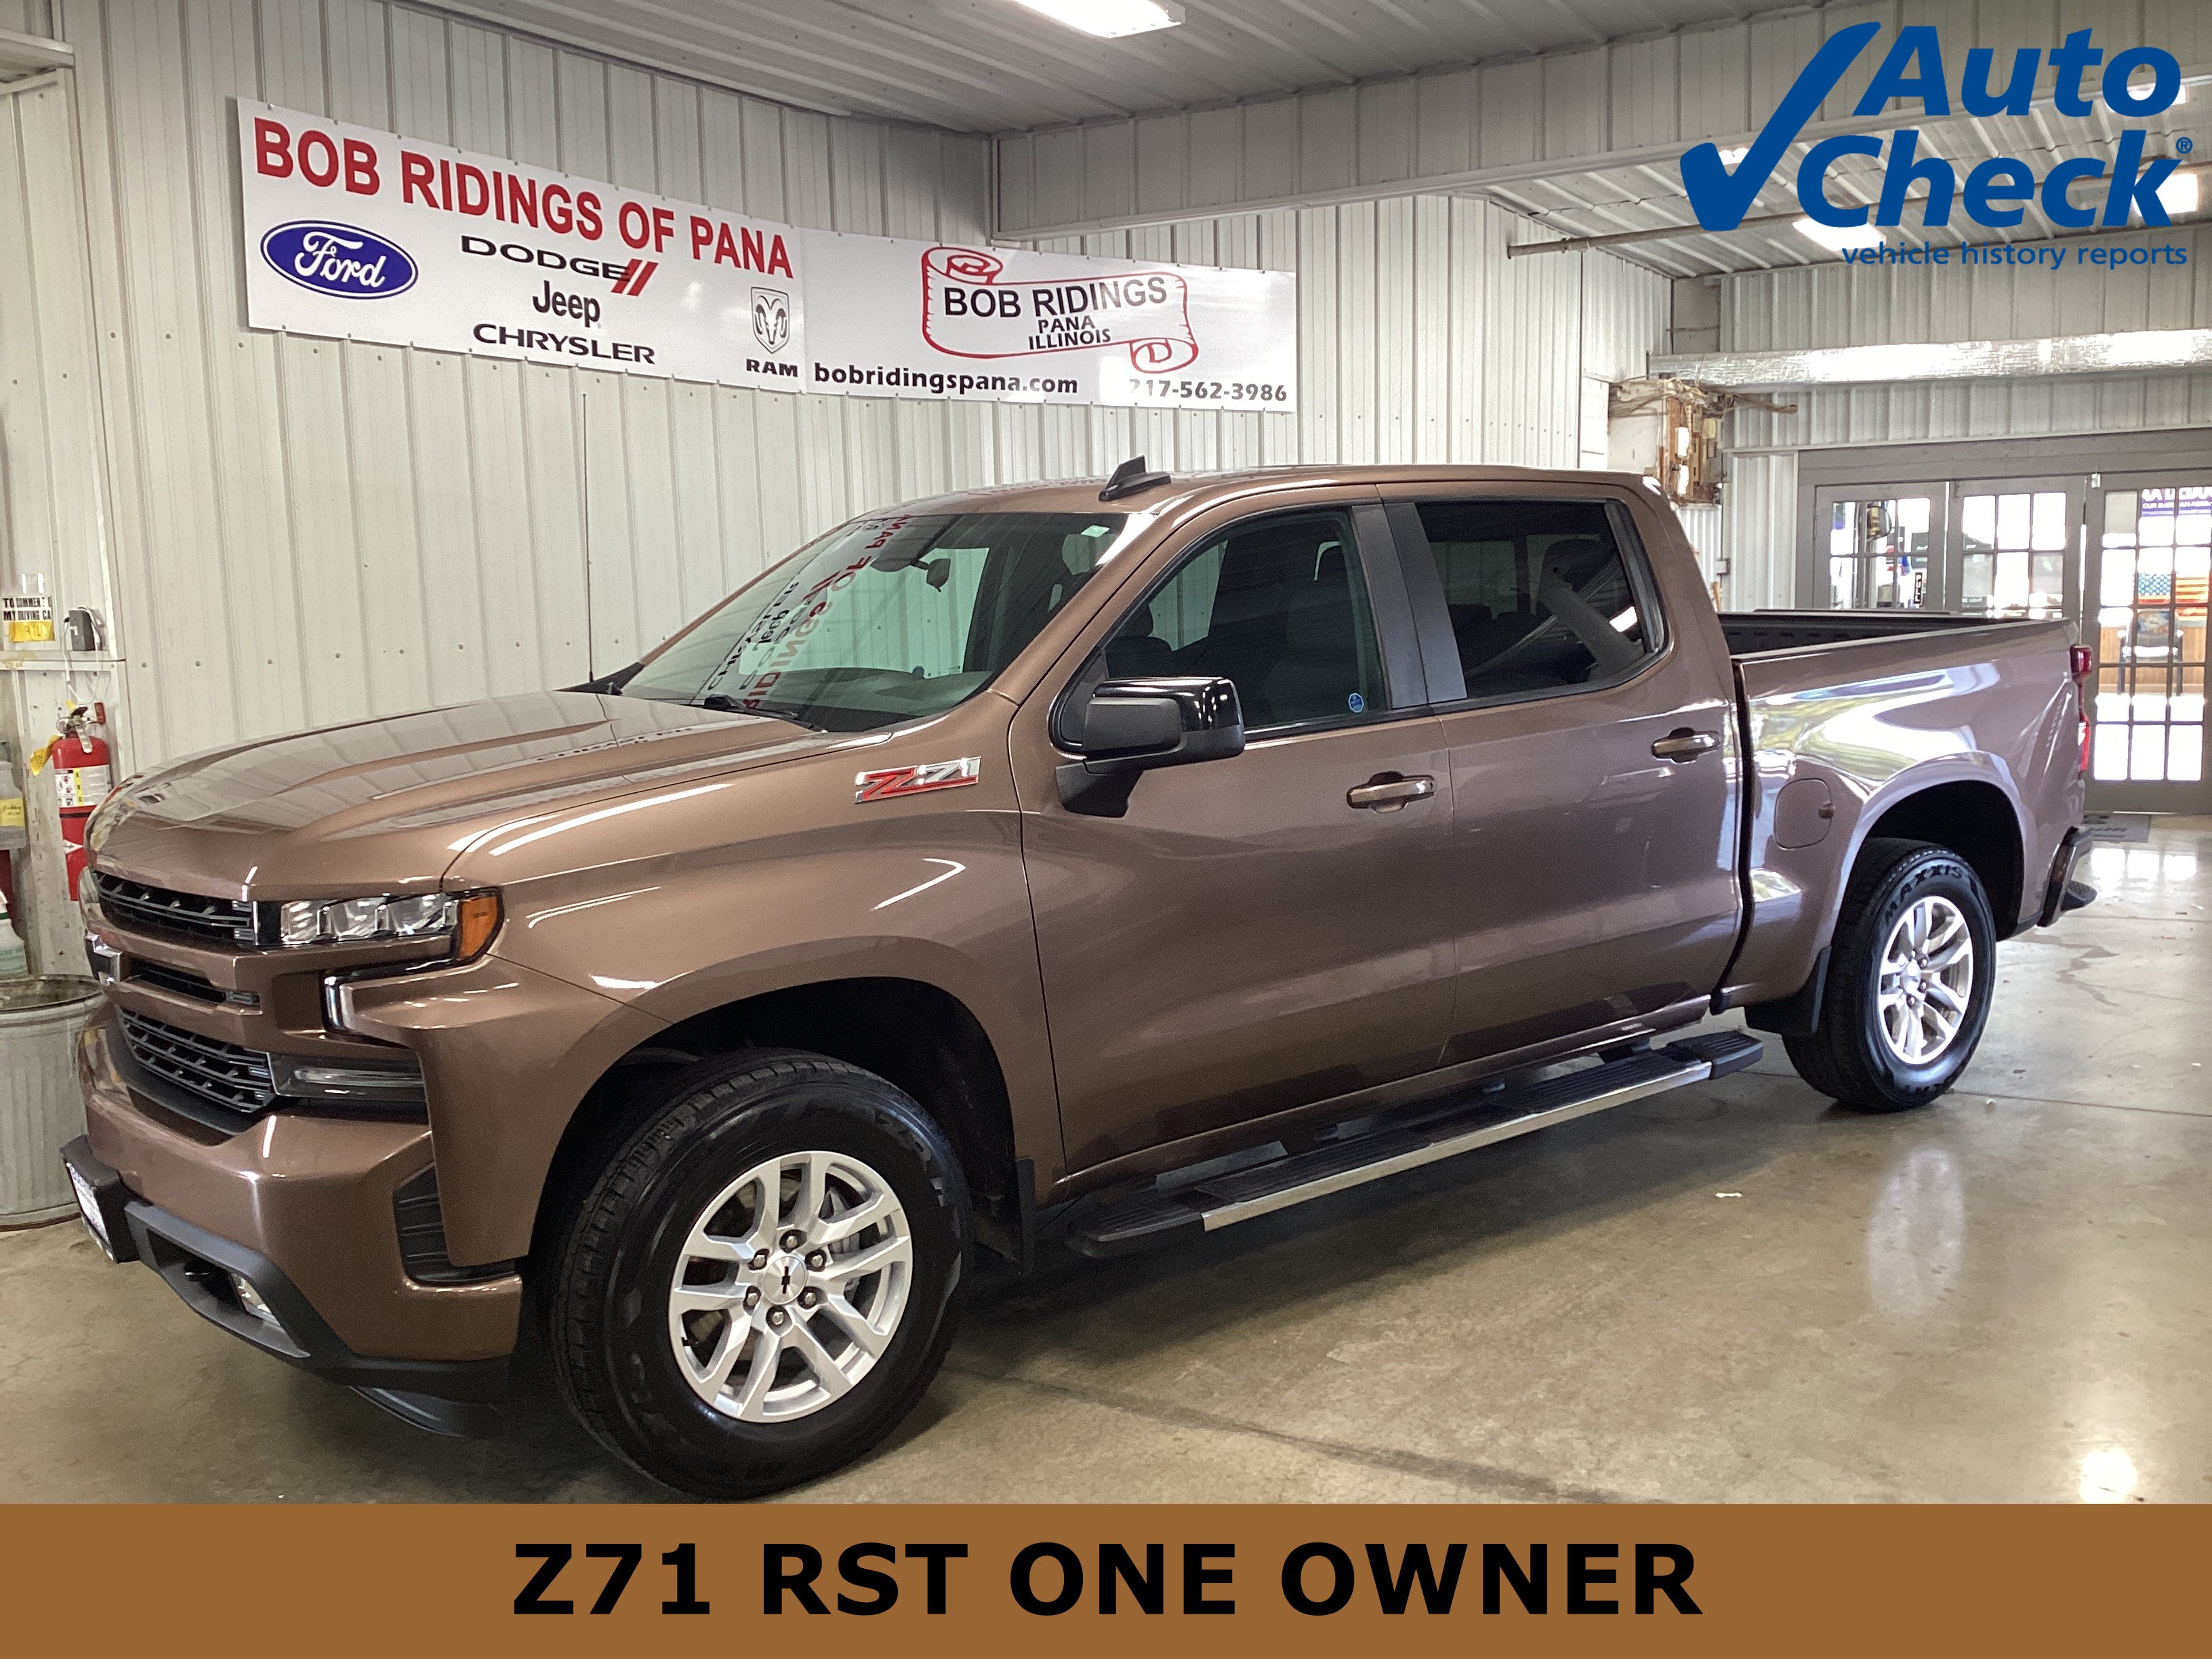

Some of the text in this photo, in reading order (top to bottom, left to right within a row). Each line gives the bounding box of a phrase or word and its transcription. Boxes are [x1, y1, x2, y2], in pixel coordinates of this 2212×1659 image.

[255, 117, 794, 279] BOB RIDINGS OF PANA
[294, 231, 387, 288] Ford
[461, 235, 632, 282] DODGE
[532, 280, 601, 328] Jeep
[944, 276, 1168, 318] BOB RIDINGS
[473, 323, 656, 365] CHRYSLER
[1028, 328, 1111, 350] ILLINOIS
[1038, 314, 1097, 334] PANA
[745, 359, 799, 378] RAM
[814, 362, 1079, 395] bobridingspana.com
[1129, 378, 1288, 402] 217-562-3986
[3, 610, 16, 621] MY
[855, 756, 983, 805] Z71
[1885, 864, 1963, 927] MAXXIS
